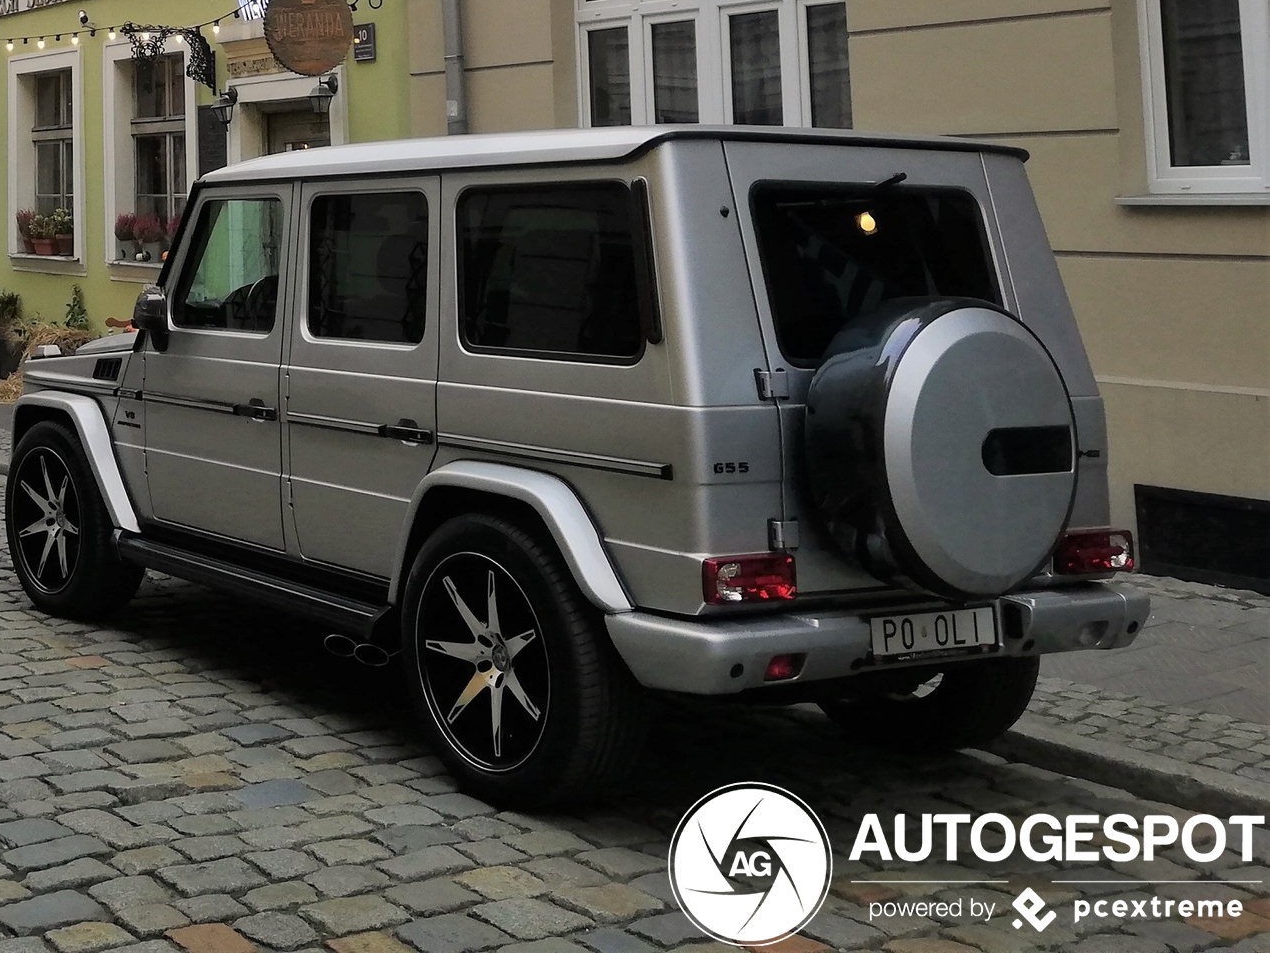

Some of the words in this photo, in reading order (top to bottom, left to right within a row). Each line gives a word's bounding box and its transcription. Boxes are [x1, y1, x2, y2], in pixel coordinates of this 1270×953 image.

[274, 12, 345, 41] WERANDA
[358, 29, 368, 41] 10
[713, 461, 750, 474] G55
[882, 617, 915, 653] PO
